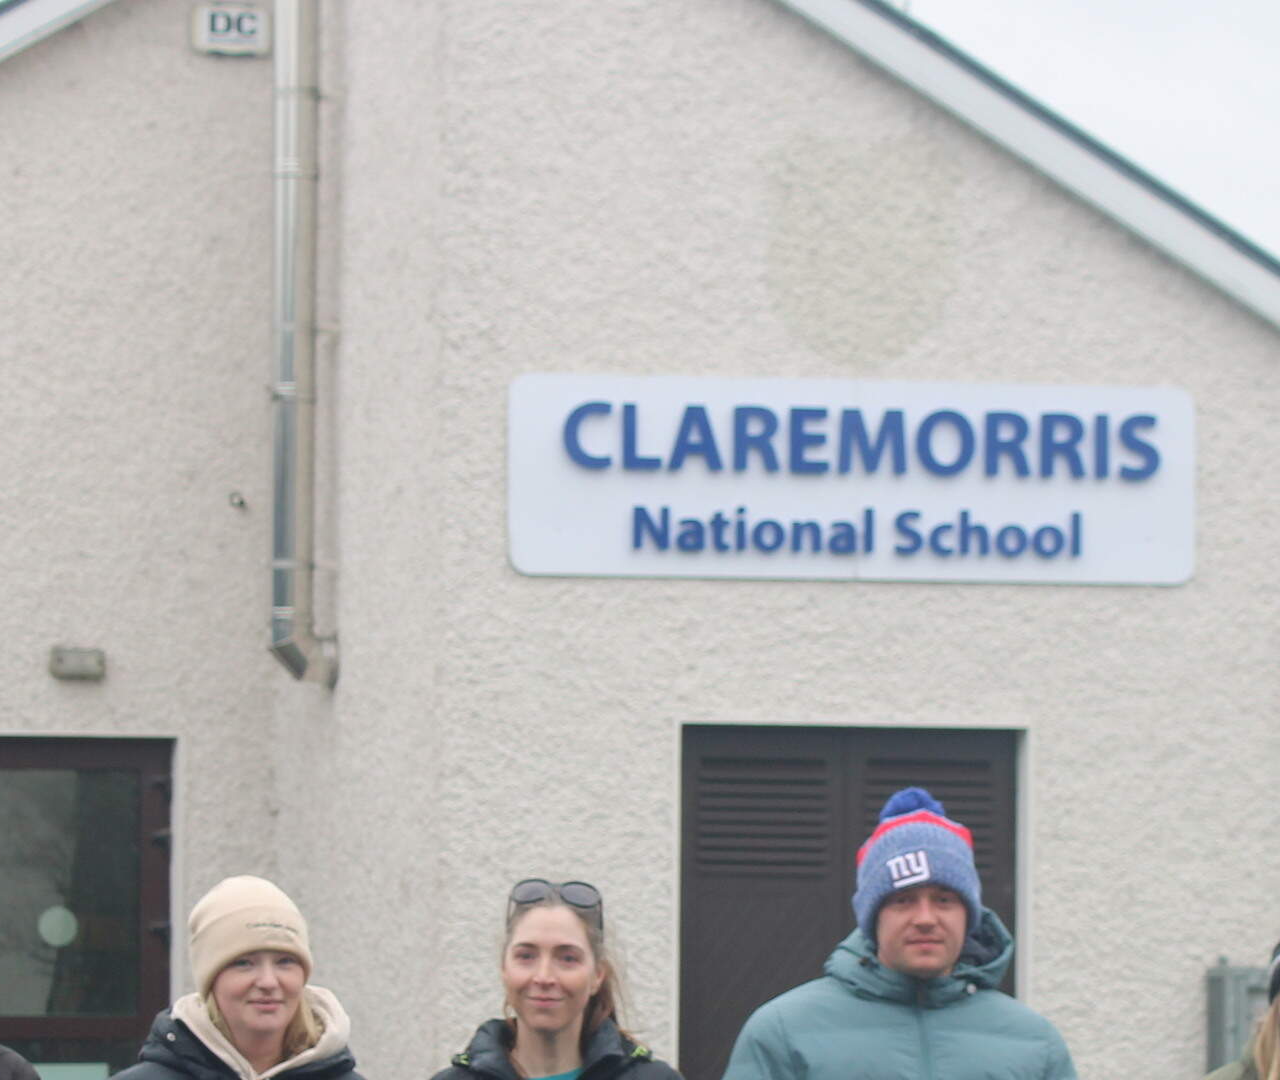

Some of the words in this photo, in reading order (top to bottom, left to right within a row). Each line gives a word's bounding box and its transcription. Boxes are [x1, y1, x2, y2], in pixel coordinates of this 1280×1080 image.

[209, 12, 257, 36] DC
[562, 401, 1161, 483] CLAREMORRIS
[631, 505, 875, 558] National
[893, 509, 1082, 561] School
